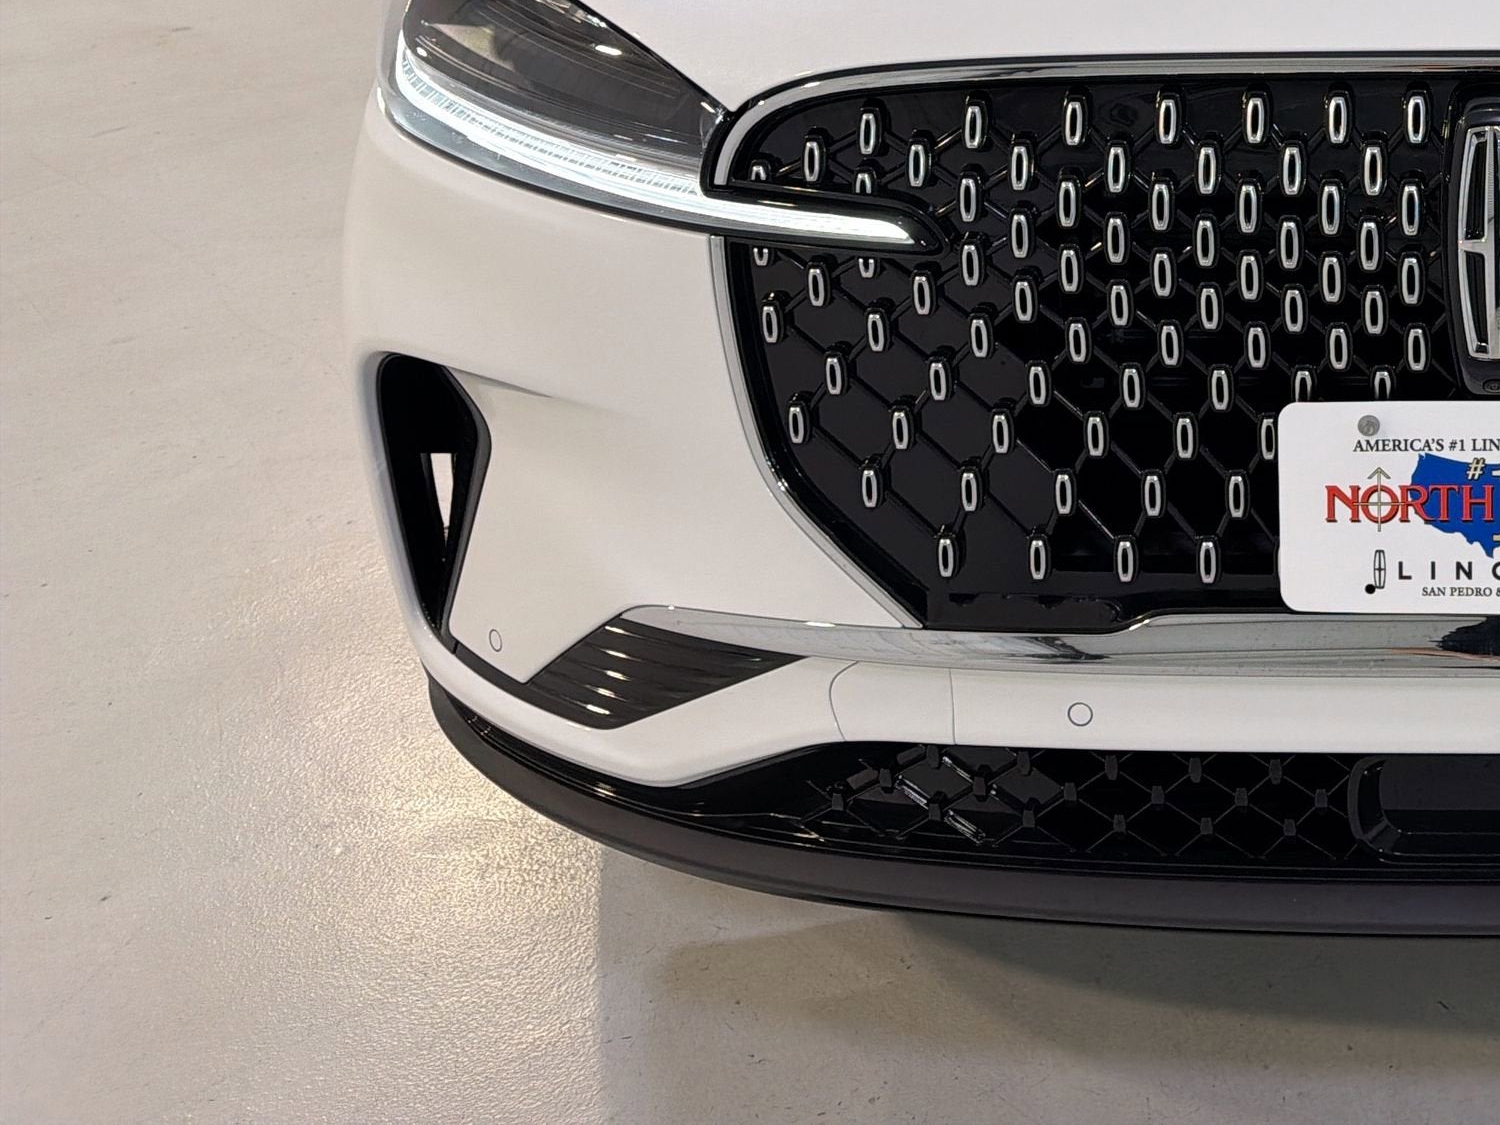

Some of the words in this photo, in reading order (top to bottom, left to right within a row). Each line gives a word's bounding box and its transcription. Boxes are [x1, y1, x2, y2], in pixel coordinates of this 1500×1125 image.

[1352, 438, 1445, 453] AMERICA'S
[1448, 438, 1467, 453] #1
[1324, 484, 1495, 524] NORTH
[1421, 586, 1447, 599] SAN
[1450, 586, 1494, 599] PEDRO
